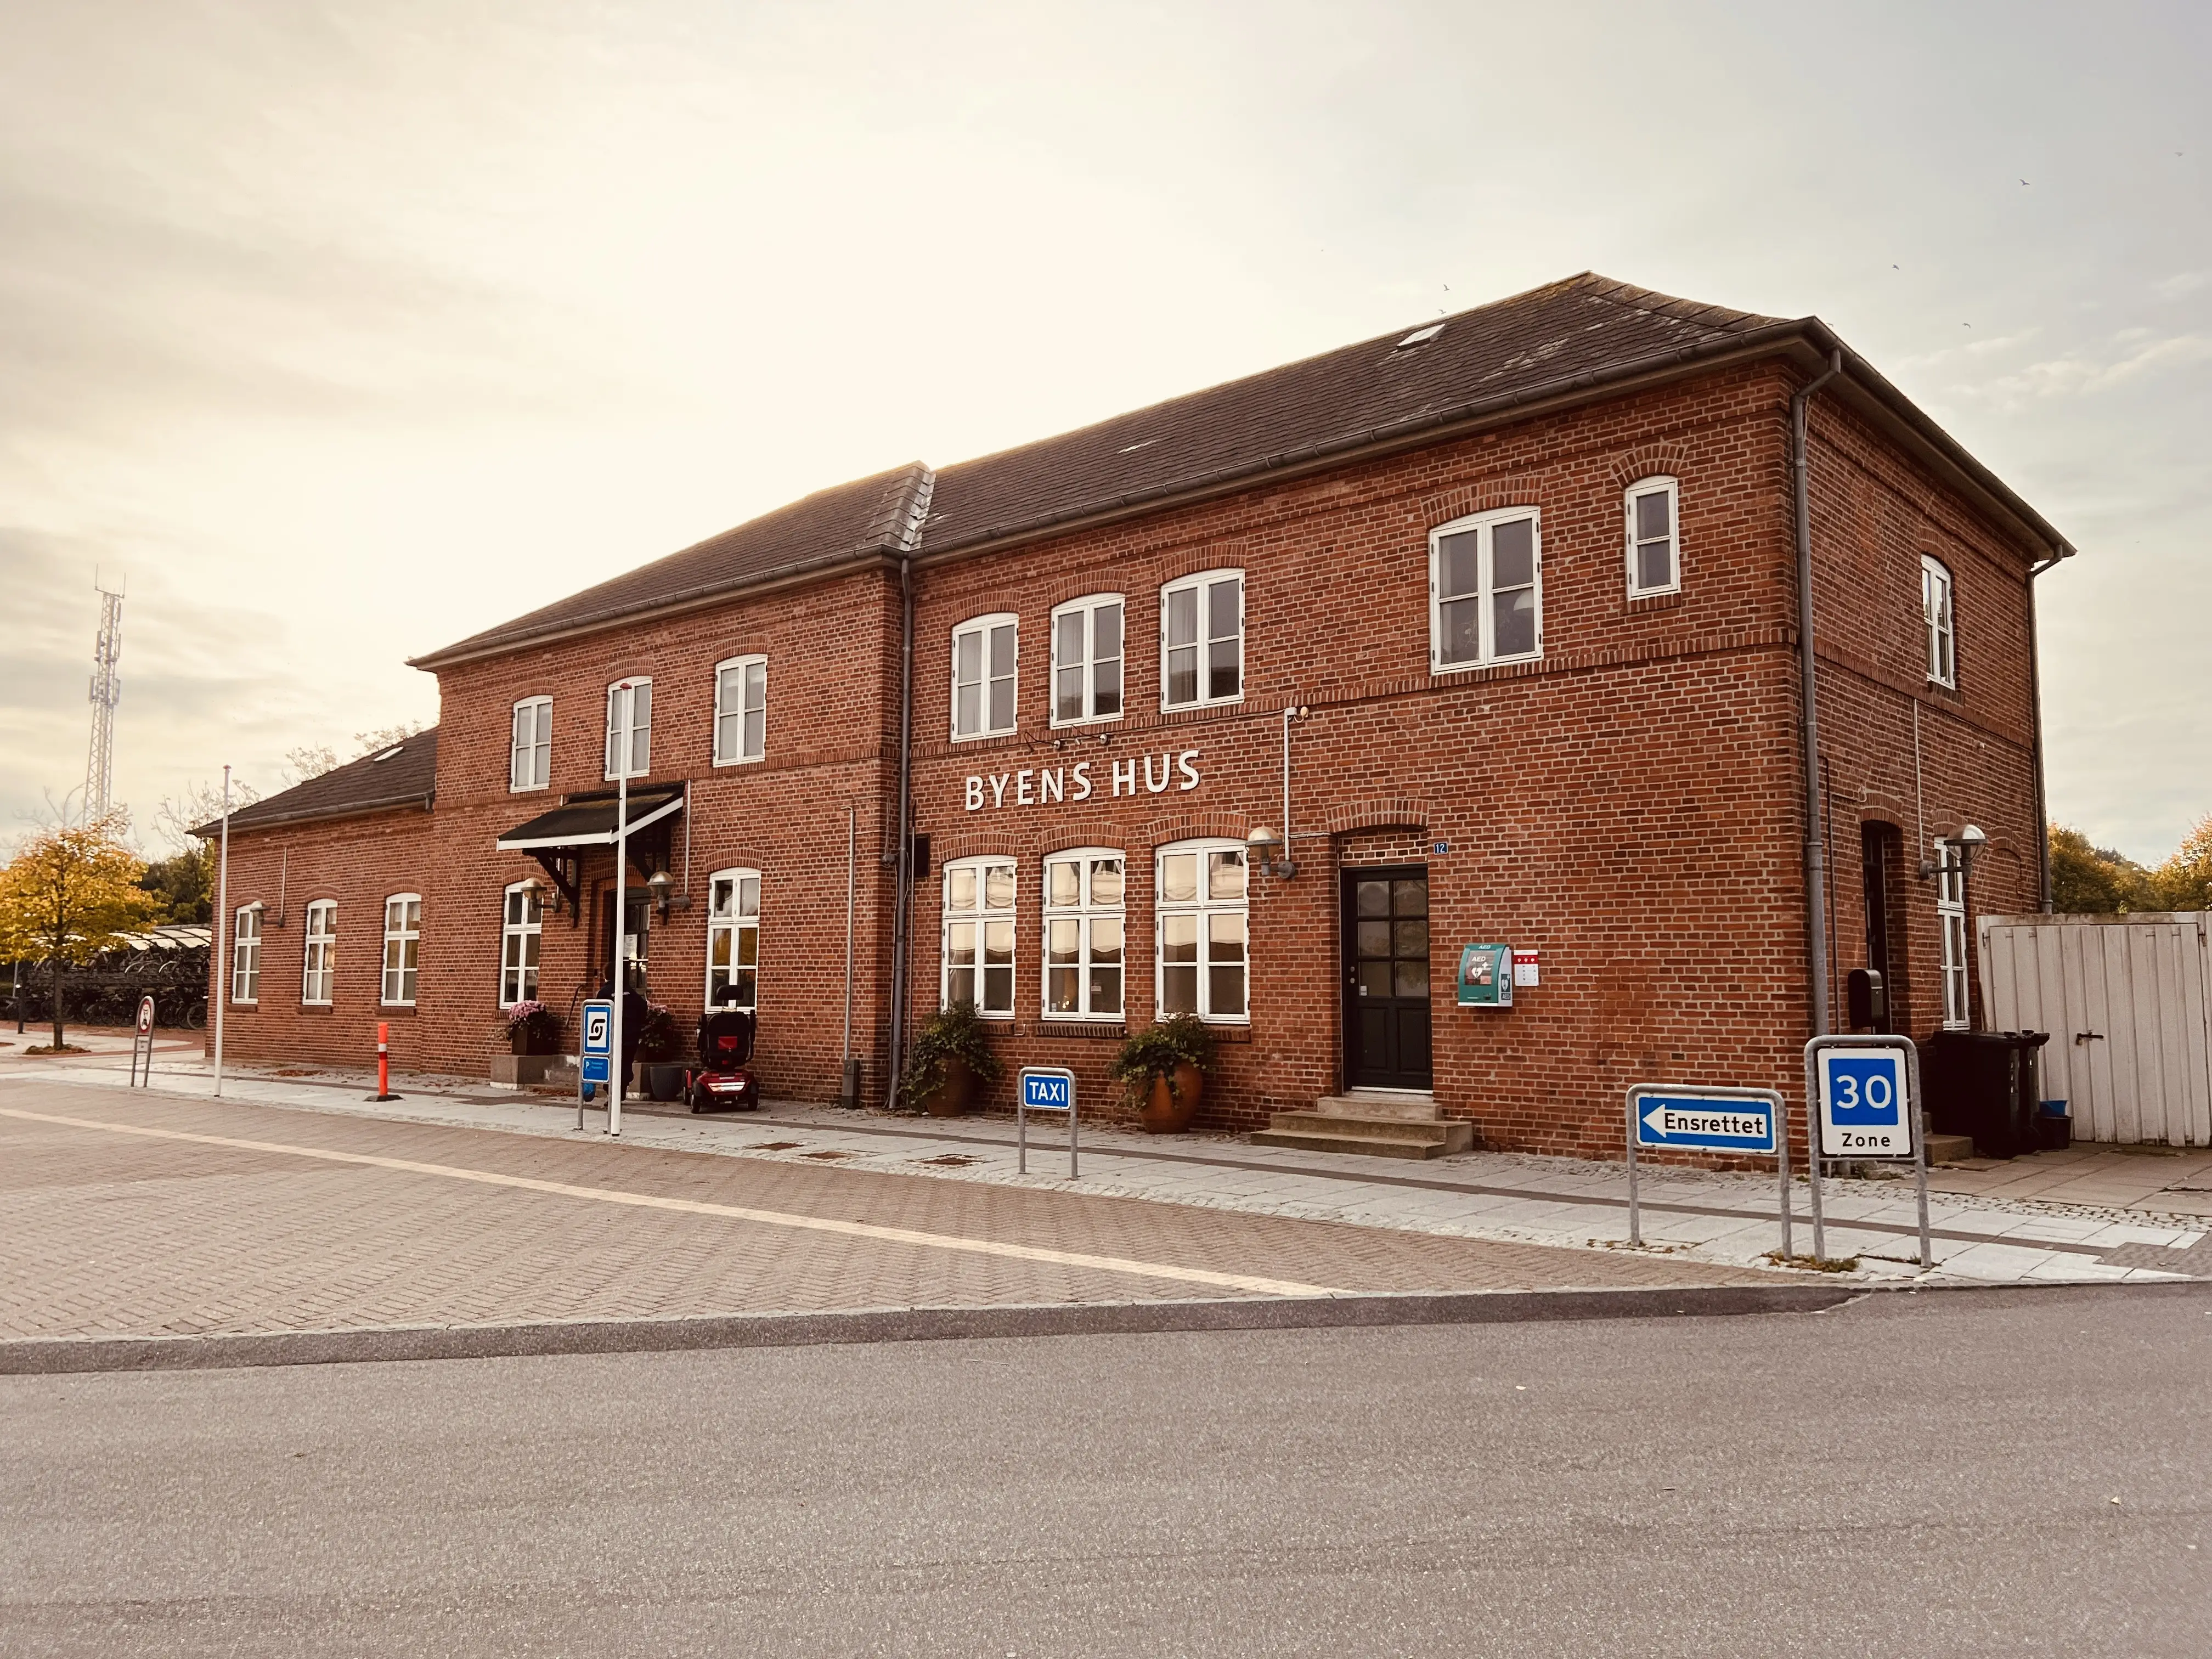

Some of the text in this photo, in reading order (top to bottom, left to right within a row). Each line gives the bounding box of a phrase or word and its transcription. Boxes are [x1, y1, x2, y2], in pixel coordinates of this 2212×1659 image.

[966, 750, 1200, 811] BYENS HUS
[1436, 843, 1445, 853] 12
[1029, 1082, 1065, 1102] TAXI
[1836, 1075, 1892, 1109] 30
[1664, 1113, 1763, 1135] Ensrettet
[1842, 1133, 1891, 1147] Zone
